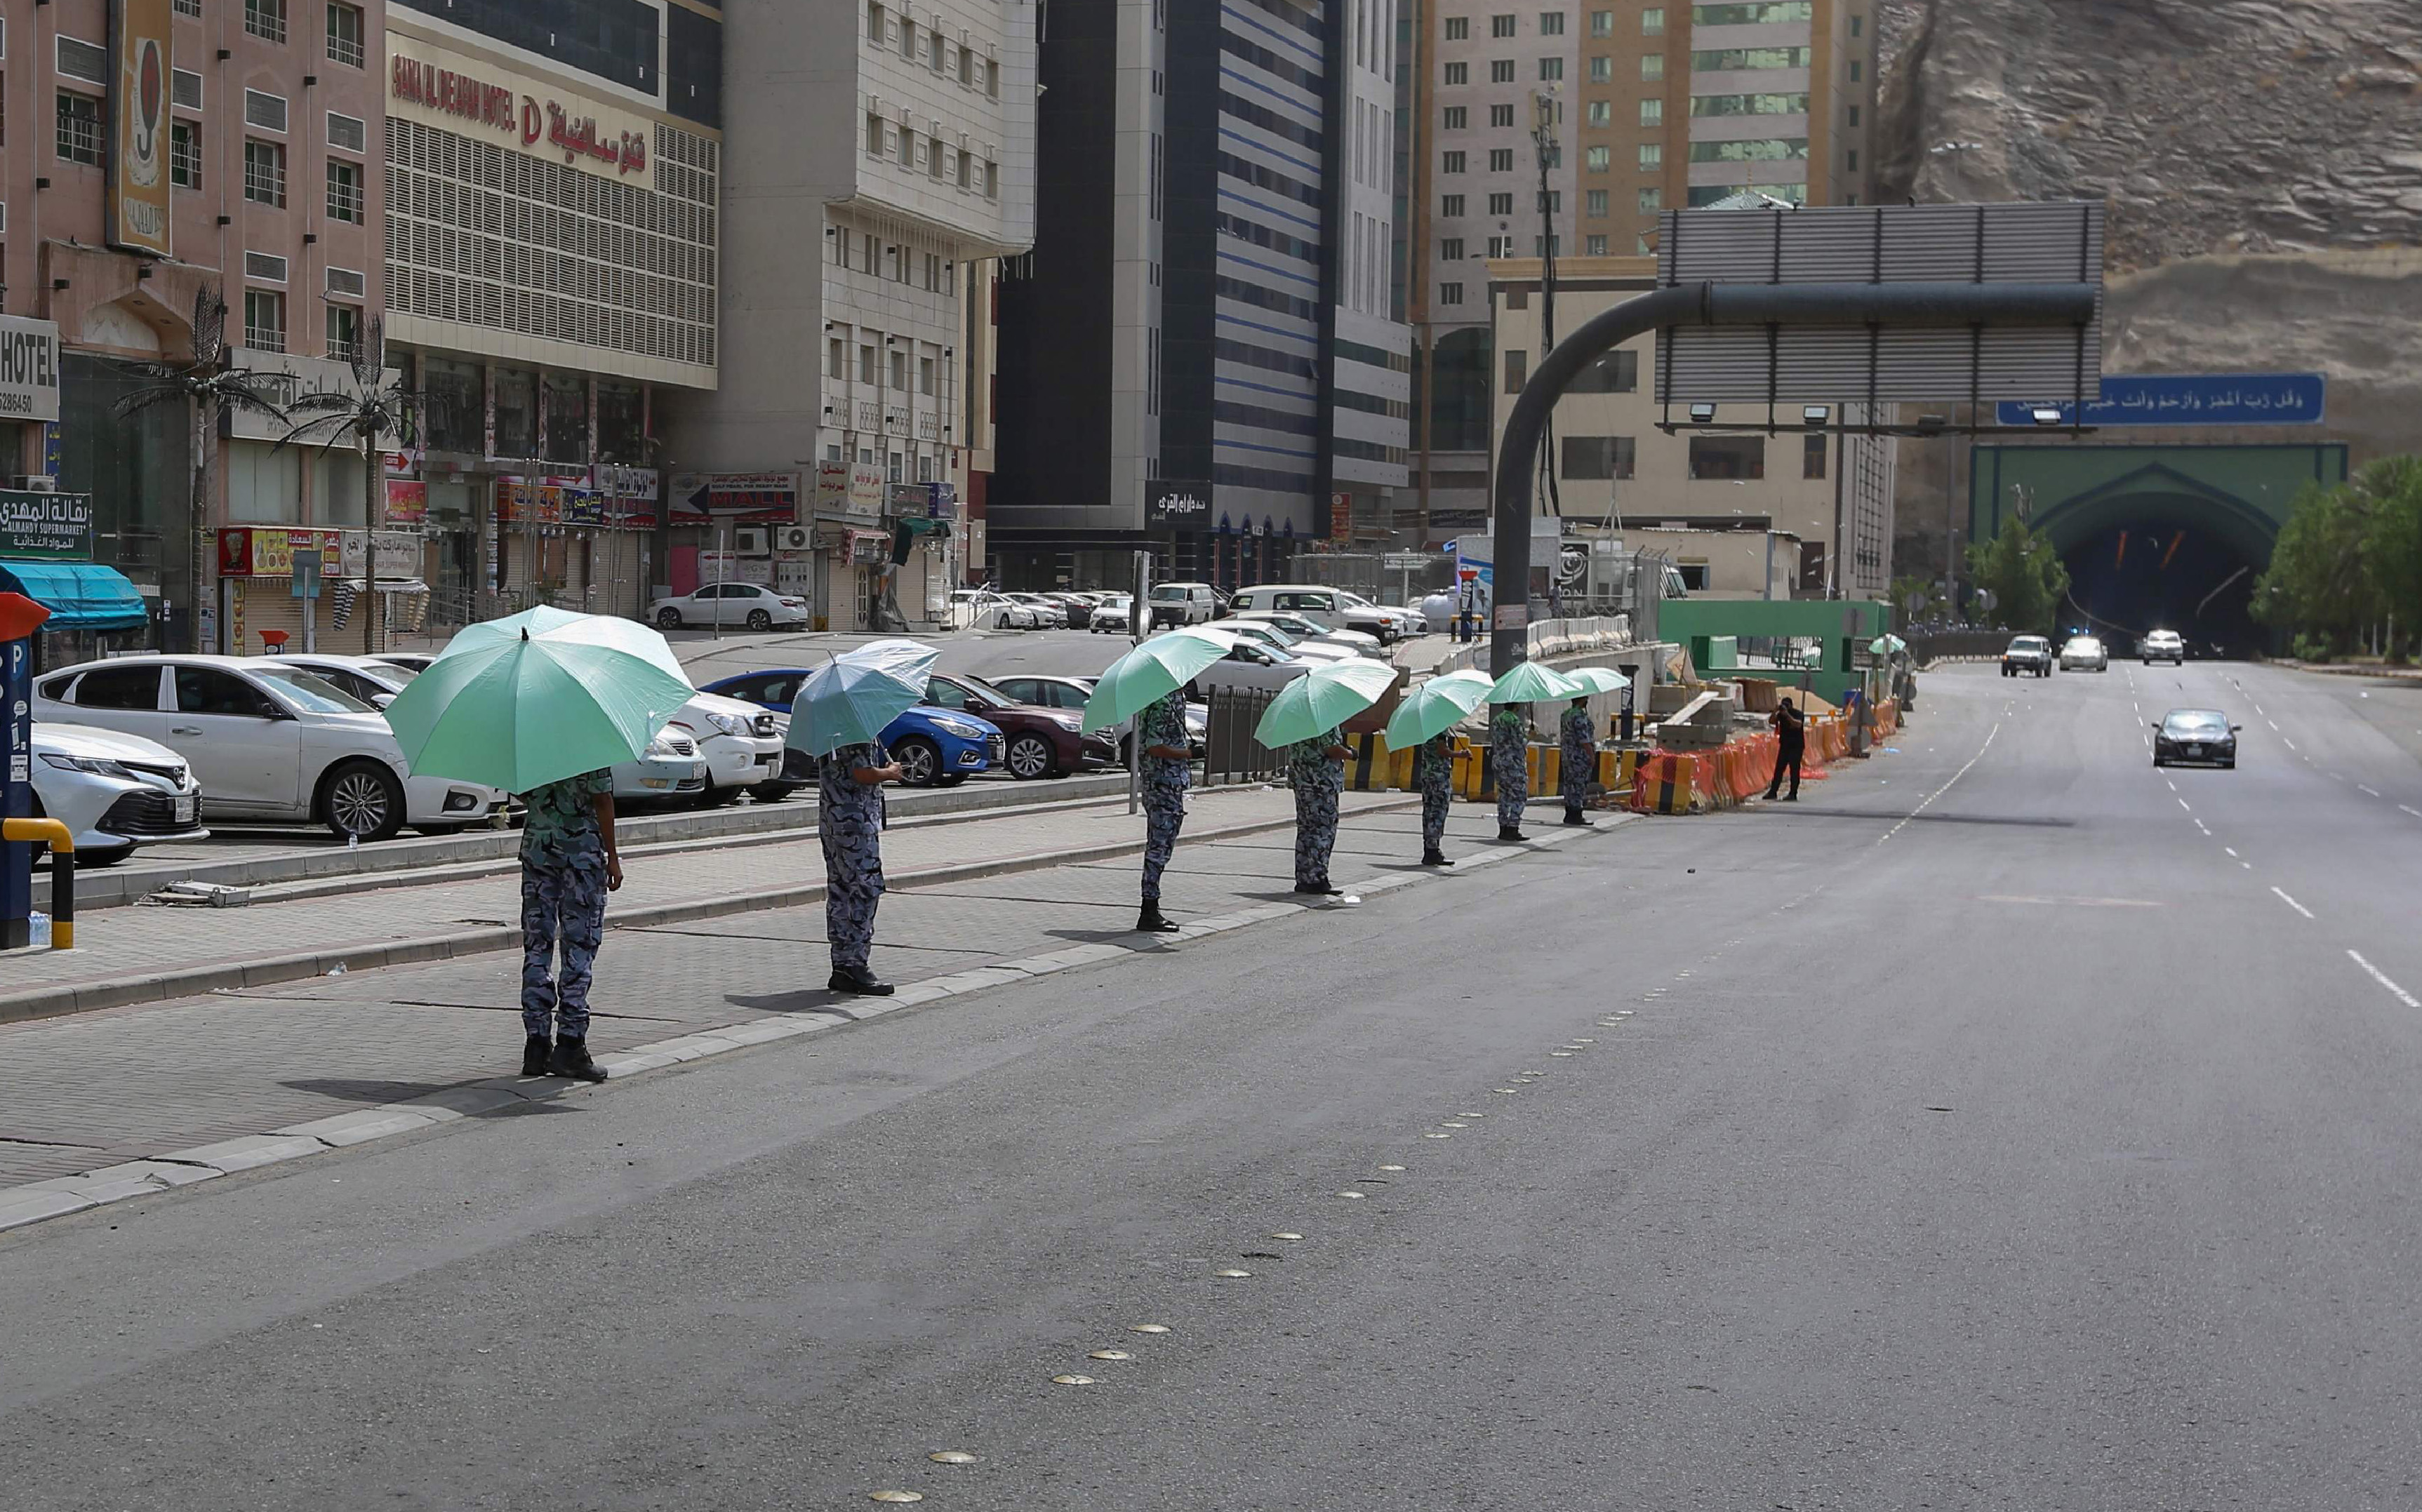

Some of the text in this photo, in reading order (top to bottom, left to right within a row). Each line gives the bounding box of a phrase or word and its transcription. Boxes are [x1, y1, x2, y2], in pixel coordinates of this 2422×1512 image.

[619, 130, 646, 175] فندق
[1, 330, 58, 388] HOTEL
[822, 464, 846, 475] محل
[707, 492, 792, 507] MALL
[52, 497, 87, 530] بقالة
[8, 521, 84, 535] ALMAHDY SUPERMARKET
[13, 534, 74, 550] للمواد الغذائية
[13, 644, 22, 674] P
